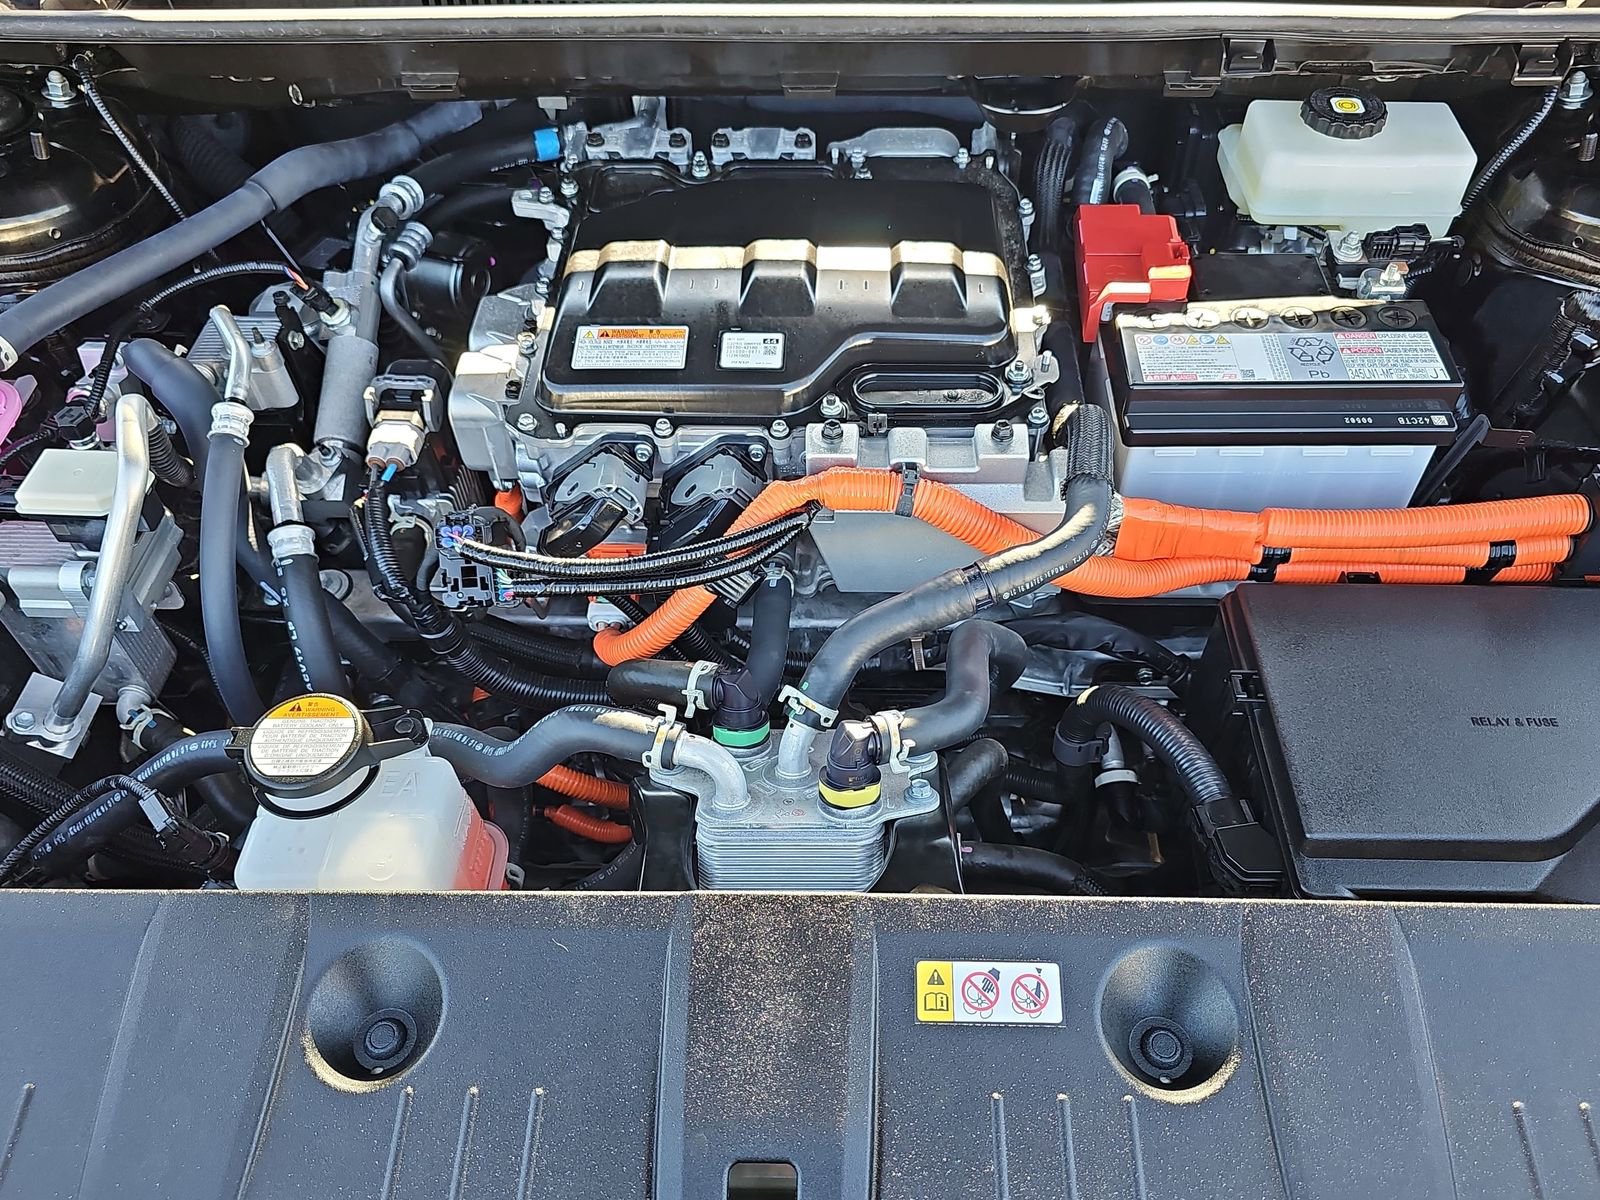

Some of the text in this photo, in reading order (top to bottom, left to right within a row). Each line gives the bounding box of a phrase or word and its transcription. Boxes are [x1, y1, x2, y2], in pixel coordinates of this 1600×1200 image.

[1309, 370, 1330, 378] Pb
[1348, 368, 1394, 379] 345LN1-MF
[288, 622, 298, 640] LP
[1470, 716, 1559, 727] RELAY & FUSE
